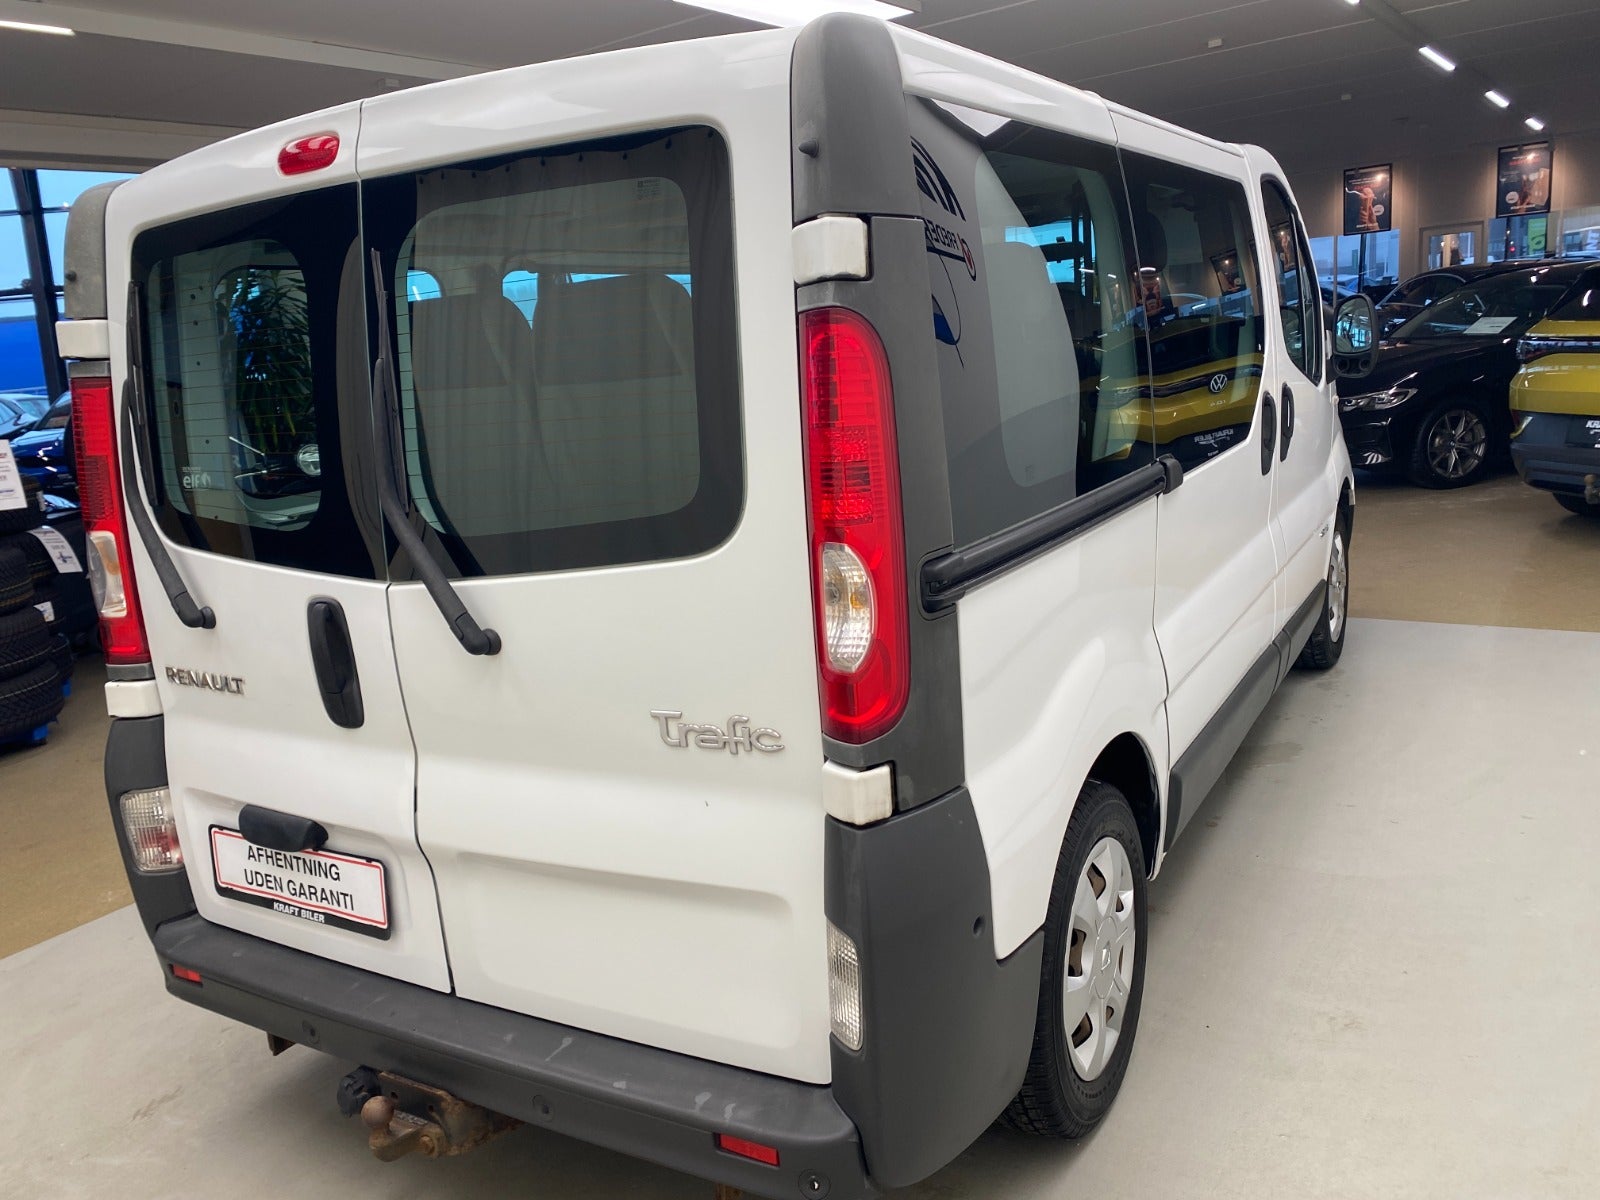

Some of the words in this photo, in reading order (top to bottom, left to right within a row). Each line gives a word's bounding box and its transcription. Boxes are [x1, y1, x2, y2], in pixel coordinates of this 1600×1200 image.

[165, 666, 245, 695] RENAULT
[650, 710, 785, 755] Trafic
[248, 845, 341, 882] AFHENTNING
[244, 868, 284, 894] UDEN
[286, 880, 355, 912] GARANTI
[273, 901, 300, 917] KRAFT
[300, 909, 325, 924] BILER
